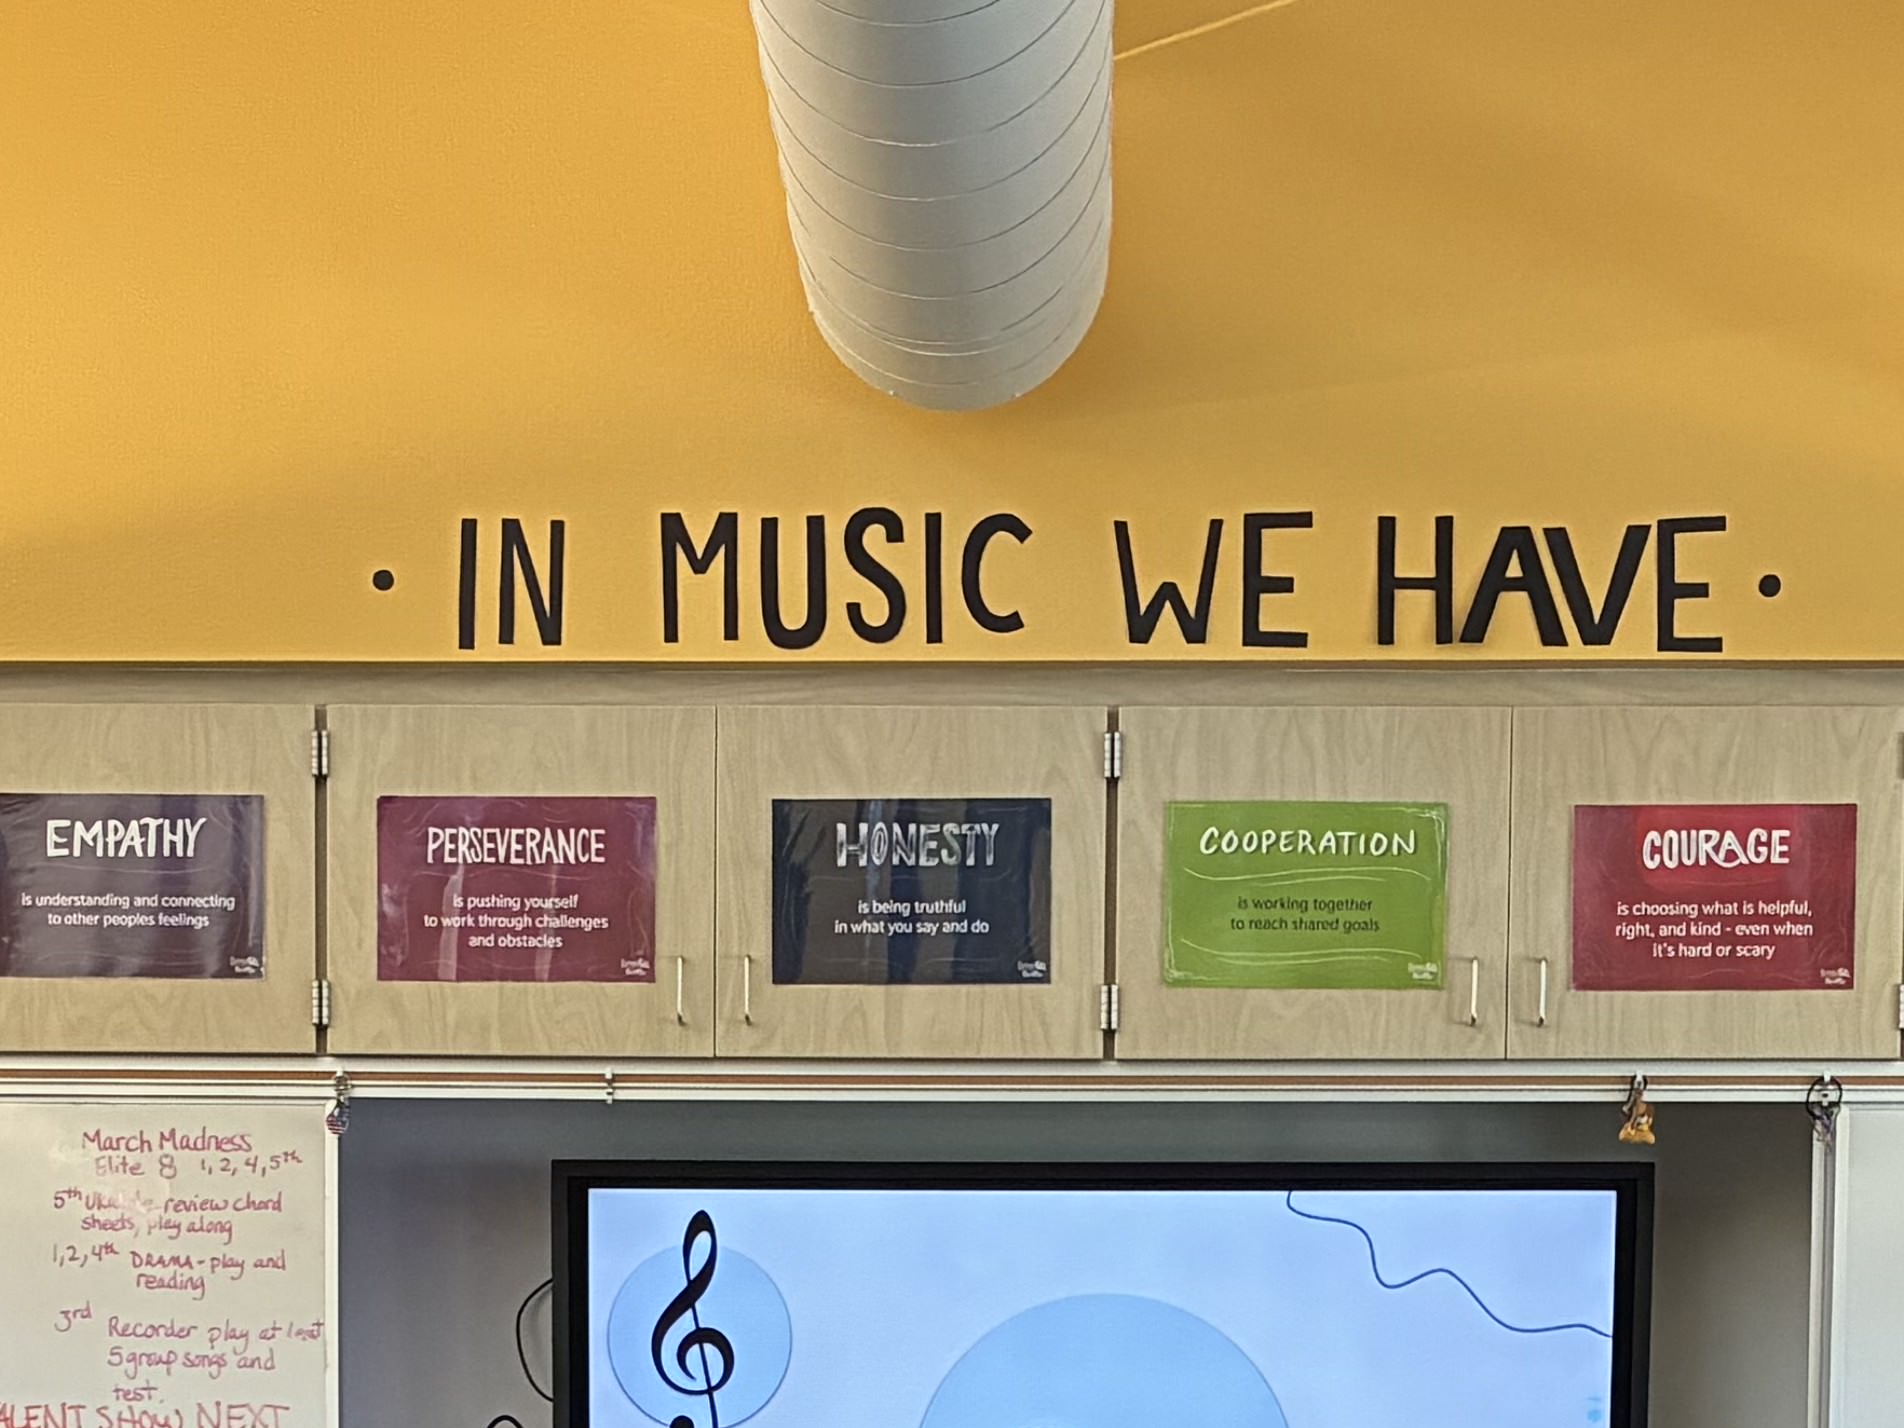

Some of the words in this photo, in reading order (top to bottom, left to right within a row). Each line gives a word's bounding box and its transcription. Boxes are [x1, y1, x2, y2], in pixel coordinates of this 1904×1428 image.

[457, 515, 566, 650] IN
[658, 506, 1034, 650] MUSIC
[1112, 510, 1315, 650] WE
[1376, 514, 1728, 654] HAVE
[45, 817, 208, 859] EMPATHY
[426, 826, 607, 867] PERSEVERANCE
[836, 822, 1000, 868] HONESTY
[1199, 825, 1417, 858] COOPERATION
[1642, 827, 1792, 870] COURAGE
[22, 893, 32, 905] is
[36, 893, 130, 909] understanding
[134, 895, 160, 906] and
[162, 895, 237, 910] connecting
[453, 893, 463, 907] is
[467, 895, 520, 911] pushing
[524, 895, 578, 910] yourself
[858, 901, 869, 913] is
[872, 900, 910, 916] being
[915, 899, 965, 913] truthful
[1238, 897, 1248, 909] is
[1252, 898, 1308, 913] working
[1313, 899, 1372, 913] together
[1617, 902, 1629, 915] is
[1633, 902, 1698, 918] choosing
[1702, 902, 1738, 914] what
[1743, 901, 1754, 914] is
[1759, 900, 1811, 916] helpful,
[48, 914, 62, 924] to
[64, 913, 99, 924] other
[103, 914, 157, 927] peoples
[157, 913, 209, 929] feelings
[424, 915, 438, 926] to
[441, 914, 474, 927] work
[478, 914, 532, 930] through
[535, 915, 608, 931] challenges
[835, 920, 847, 933] in
[851, 920, 884, 933] what
[888, 923, 912, 935] you
[916, 923, 939, 935] say
[942, 920, 967, 932] and
[971, 920, 989, 932] do
[1231, 919, 1244, 929] to
[1249, 918, 1288, 930] reach
[1292, 918, 1339, 930] shared
[1343, 919, 1379, 934] goals
[1616, 923, 1654, 940] right,
[1659, 923, 1686, 936] and
[1690, 922, 1721, 935] kind
[1735, 925, 1769, 935] even
[1773, 922, 1813, 935] when
[469, 934, 494, 946] and
[498, 934, 562, 948] obstacles
[1653, 943, 1675, 957] it's
[1679, 943, 1712, 957] hard
[1716, 946, 1731, 956] or
[1736, 946, 1775, 959] scary
[82, 1129, 153, 1153] March
[159, 1127, 253, 1152] Madness
[159, 1154, 177, 1179] 8
[136, 1274, 206, 1300] reading
[108, 1316, 198, 1339] Recorder
